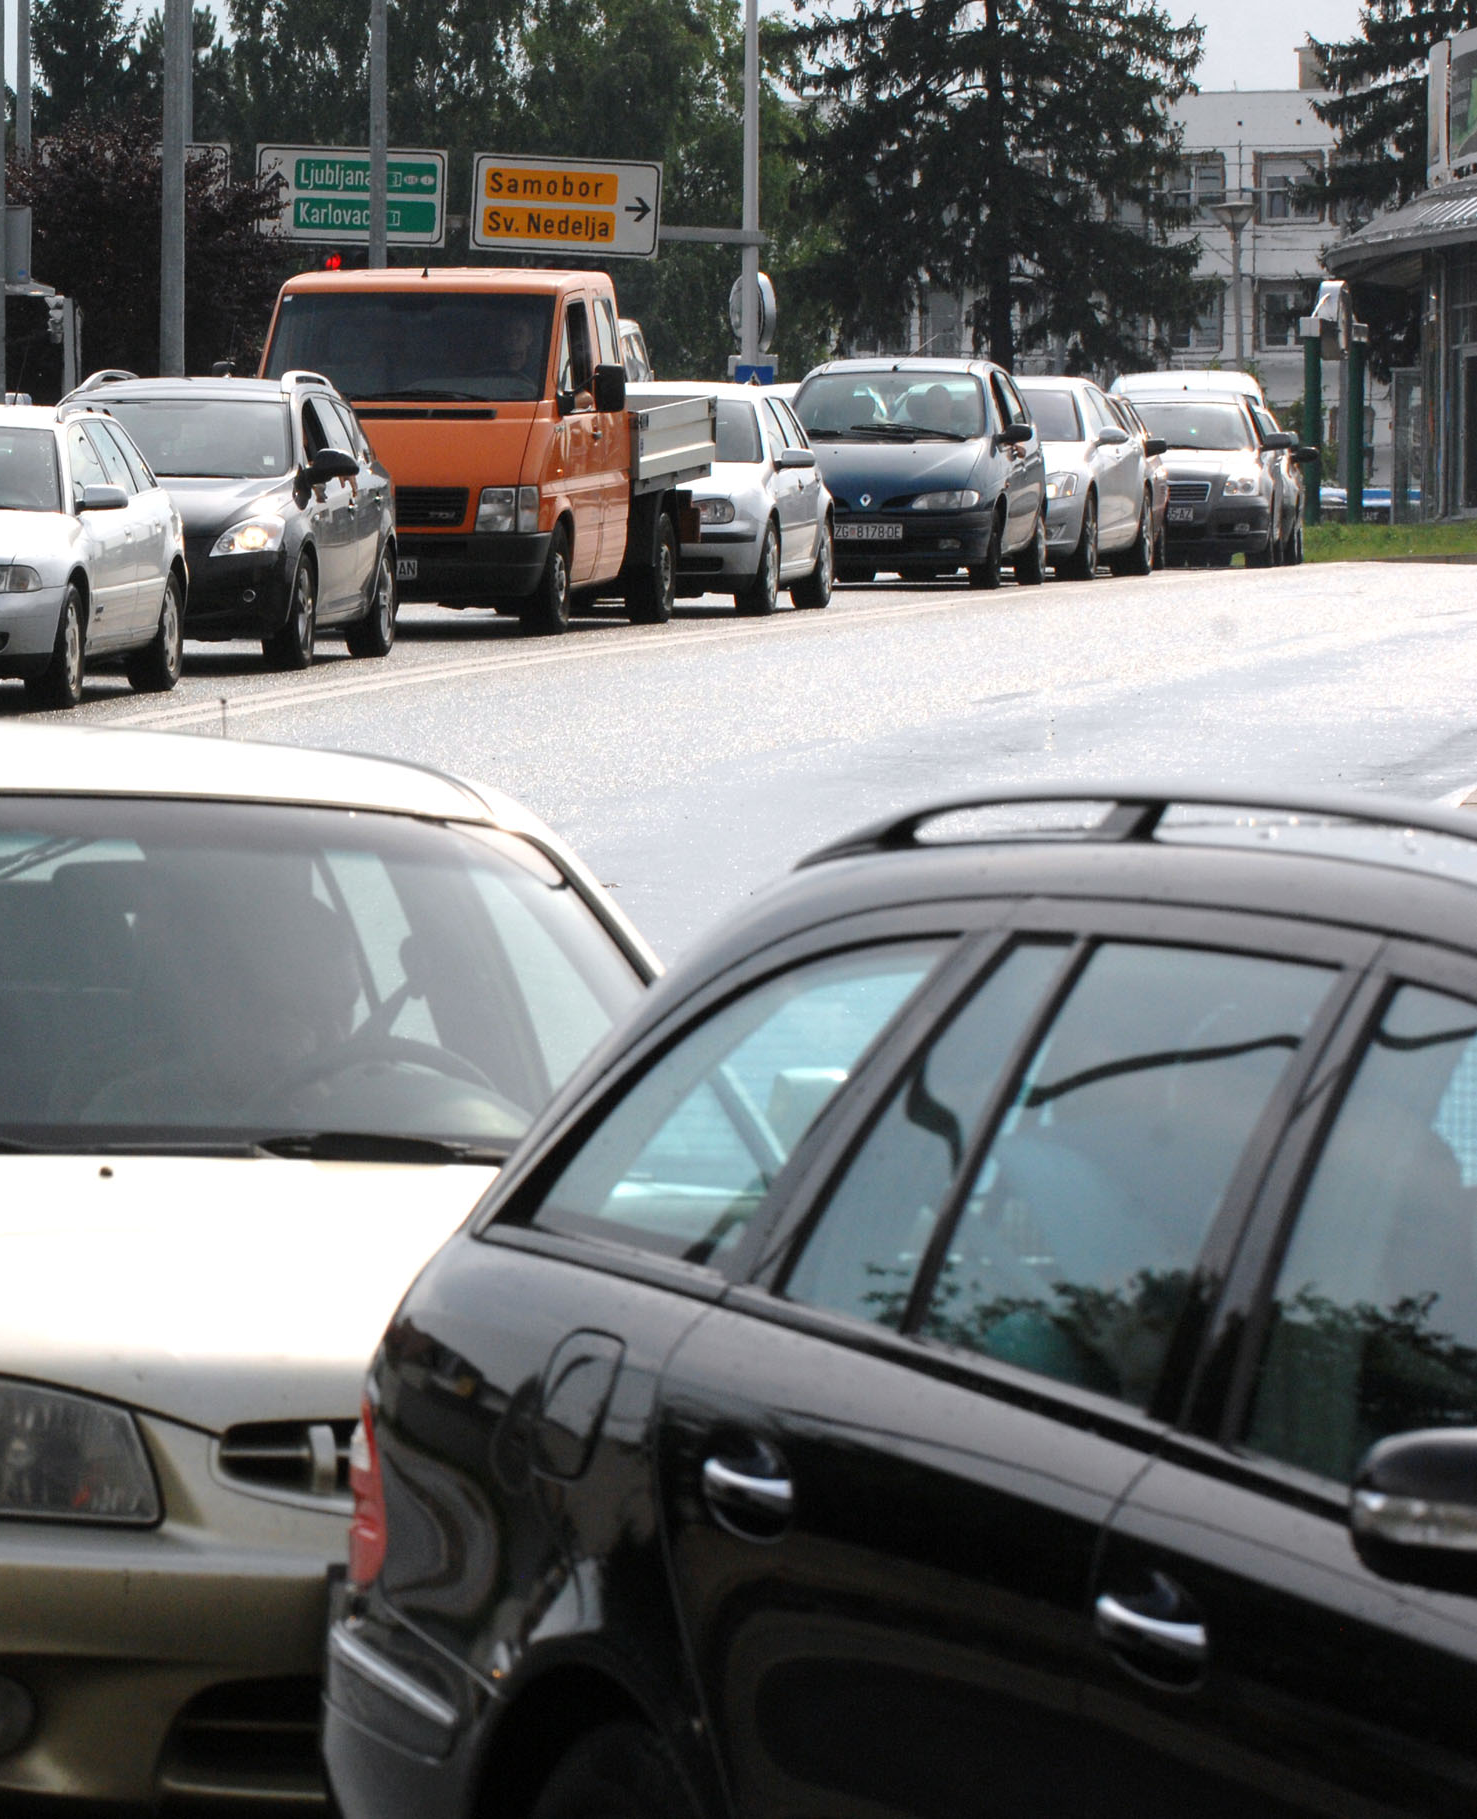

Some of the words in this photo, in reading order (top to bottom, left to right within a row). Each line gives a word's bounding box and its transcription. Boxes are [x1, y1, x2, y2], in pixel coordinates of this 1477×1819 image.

[300, 163, 371, 190] Ljubljana
[490, 172, 603, 198] Samobor
[299, 202, 371, 225] Karlovac
[488, 211, 519, 233] Sv.
[527, 213, 609, 241] Nedelja
[835, 525, 849, 538] ZG
[398, 561, 416, 577] AN
